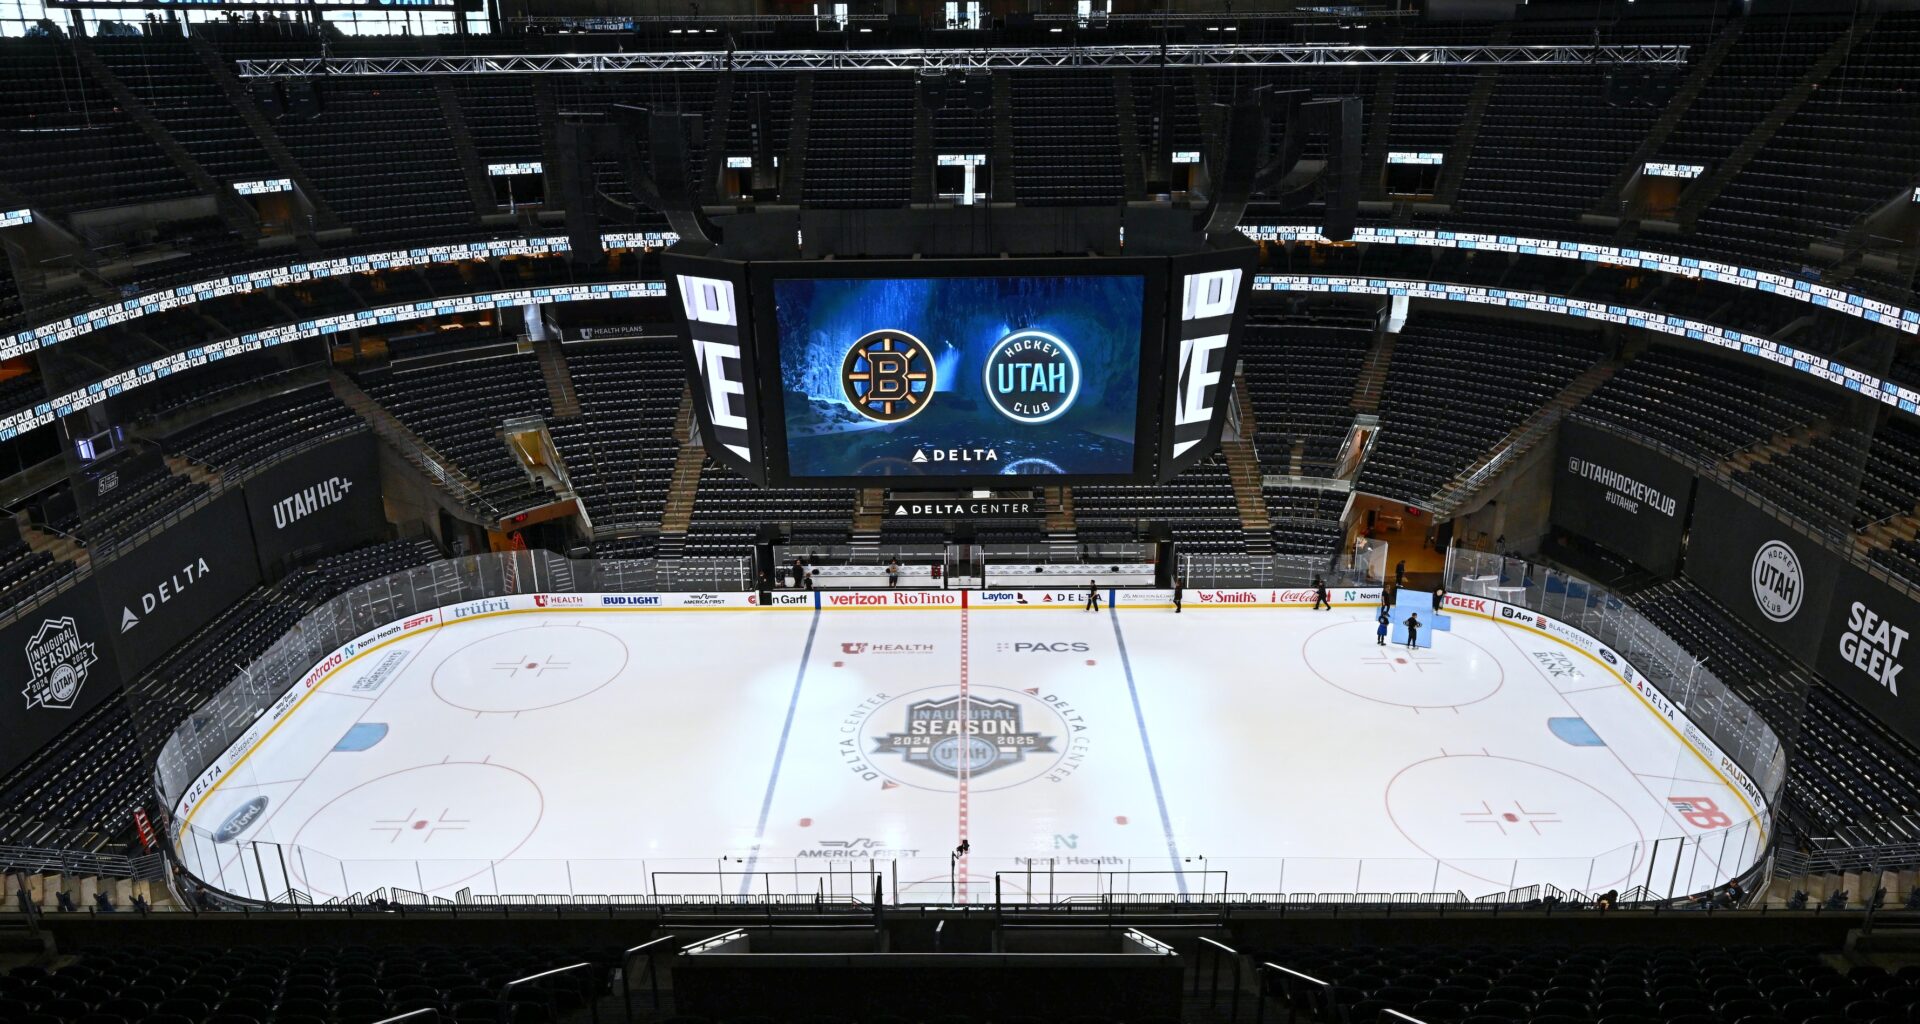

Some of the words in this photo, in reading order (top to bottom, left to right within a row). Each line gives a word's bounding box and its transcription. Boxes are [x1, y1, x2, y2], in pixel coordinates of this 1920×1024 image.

[1438, 232, 1456, 240] UTAH
[411, 249, 428, 257] UTAH
[428, 246, 451, 255] HOCKEY
[451, 245, 467, 253] CLUB
[432, 253, 449, 261] UTAH
[449, 251, 473, 260] HOCKEY
[473, 249, 490, 257] CLUB
[291, 264, 308, 273] UTAH
[308, 261, 332, 271] HOCKEY
[331, 259, 348, 268] CLUB
[314, 268, 331, 277] UTAH
[331, 265, 354, 275] HOCKEY
[354, 263, 370, 272] CLUB
[176, 286, 192, 296] UTAH
[192, 281, 214, 293] HOCKEY
[214, 278, 229, 288] CLUB
[1256, 276, 1272, 284] UTAH
[124, 299, 139, 310] UTAH
[139, 294, 160, 306] HOCKEY
[160, 290, 174, 301] CLUB
[415, 301, 432, 312] UTAH
[432, 298, 456, 310] HOCKEY
[455, 296, 472, 307] CLUB
[73, 314, 88, 325] UTAH
[88, 308, 108, 321] HOCKEY
[108, 304, 122, 315] CLUB
[93, 317, 108, 328] UTAH
[108, 312, 128, 324] HOCKEY
[128, 308, 142, 318] CLUB
[378, 314, 395, 324] UTAH
[395, 310, 419, 322] HOCKEY
[418, 308, 435, 318] CLUB
[1609, 306, 1626, 316] UTAH
[18, 331, 34, 343] UTAH
[34, 324, 56, 338] HOCKEY
[56, 319, 71, 331] CLUB
[41, 334, 56, 346] UTAH
[56, 327, 77, 341] HOCKEY
[77, 323, 91, 334] CLUB
[242, 334, 258, 344] UTAH
[258, 329, 281, 341] HOCKEY
[280, 325, 296, 336] CLUB
[621, 325, 643, 333] PLANS
[208, 350, 224, 361] UTAH
[224, 344, 247, 357] HOCKEY
[246, 341, 262, 351] CLUB
[1004, 339, 1061, 358] HOCKEY
[138, 363, 152, 374] UTAH
[152, 357, 172, 370] HOCKEY
[172, 353, 185, 364] CLUB
[868, 352, 908, 400] B
[998, 362, 1066, 394] UTAH
[35, 403, 50, 416] UTAH
[50, 395, 72, 410] HOCKEY
[71, 389, 86, 402] CLUB
[57, 405, 72, 418] UTAH
[72, 397, 92, 412] HOCKEY
[91, 391, 105, 404] CLUB
[1014, 401, 1050, 415] CLUB
[933, 449, 998, 462] DELTA
[1568, 456, 1676, 517] @UTAHHOCKEYCLUB
[272, 486, 317, 530] UTAH
[317, 476, 353, 509] HC+
[912, 504, 964, 514] DELTA
[970, 504, 1029, 514] CENTER
[1605, 490, 1639, 515] #UTAHHC
[1768, 550, 1796, 574] HOCKEY
[141, 557, 210, 615] DELTA
[1759, 560, 1796, 605] UTAH
[603, 596, 626, 605] BUD
[627, 596, 659, 605] LIGHT
[781, 595, 807, 604] Garff
[829, 593, 887, 605] verizon
[982, 592, 1014, 601] Layton
[1215, 590, 1257, 603] Smith's
[1443, 595, 1486, 613] TGEEK
[1762, 595, 1781, 613] CLUB
[454, 598, 510, 618] trüfrü
[1514, 611, 1533, 622] App
[403, 614, 433, 630] ESPN
[1848, 601, 1909, 658] SEAT
[357, 636, 376, 649] Nomi
[377, 625, 401, 639] Health
[1548, 622, 1569, 636] BLACK
[1570, 631, 1593, 647] DESERT
[30, 627, 74, 662] INAUGURAL
[1015, 642, 1090, 652] PACS
[34, 637, 78, 678] SEASON
[72, 649, 87, 665] 2025
[1532, 651, 1568, 678] BANK
[1839, 631, 1904, 697] GEEK
[305, 653, 342, 688] entrata
[31, 676, 48, 693] 2024
[54, 672, 74, 694] UTAH
[840, 692, 891, 733] CENTER
[1043, 694, 1087, 732] DELTA
[1645, 687, 1675, 721] DELTA
[913, 709, 1015, 720] INAUGURAL
[912, 720, 1016, 735] SEASON
[894, 736, 931, 745] 2024
[997, 736, 1034, 745] 2025
[838, 738, 879, 781] DELTA
[941, 748, 987, 760] UTAH
[1044, 736, 1090, 783] CENTER
[190, 765, 222, 803] DELTA
[224, 804, 261, 835] Ford
[797, 849, 869, 858] AMERICA
[1066, 856, 1124, 865] Health
